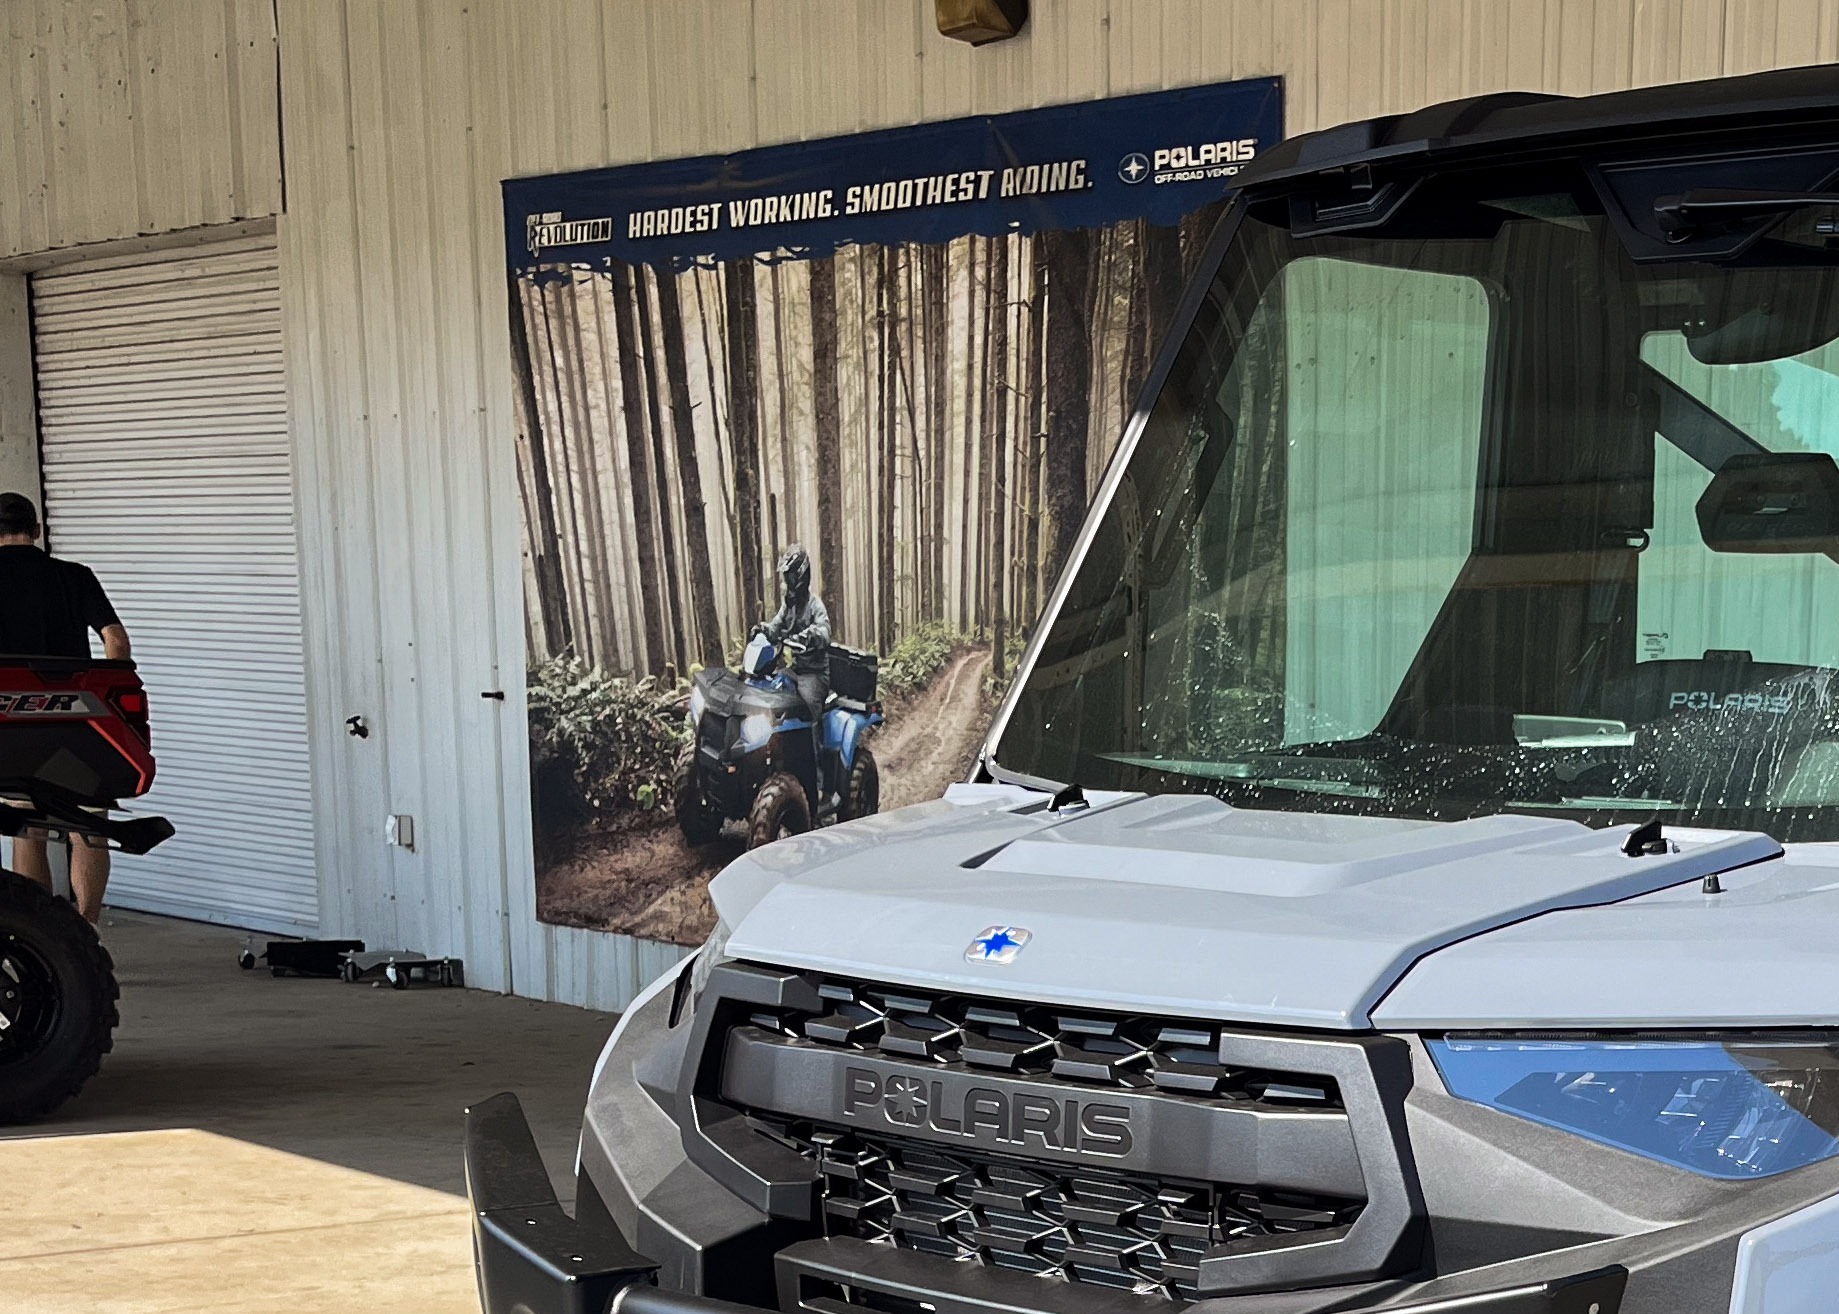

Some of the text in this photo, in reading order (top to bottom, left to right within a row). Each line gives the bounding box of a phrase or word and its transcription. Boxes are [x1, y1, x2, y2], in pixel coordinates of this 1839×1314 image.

[1154, 139, 1255, 171] POLARIS
[1154, 171, 1204, 185] OFF-ROAD
[628, 203, 722, 239] HARDEST
[729, 189, 839, 228] WORKING.
[846, 170, 995, 214] SMOOTHEST
[528, 219, 611, 256] REVOLUTION
[1669, 691, 1793, 715] POLARIS
[843, 1065, 1134, 1159] POLARIS
